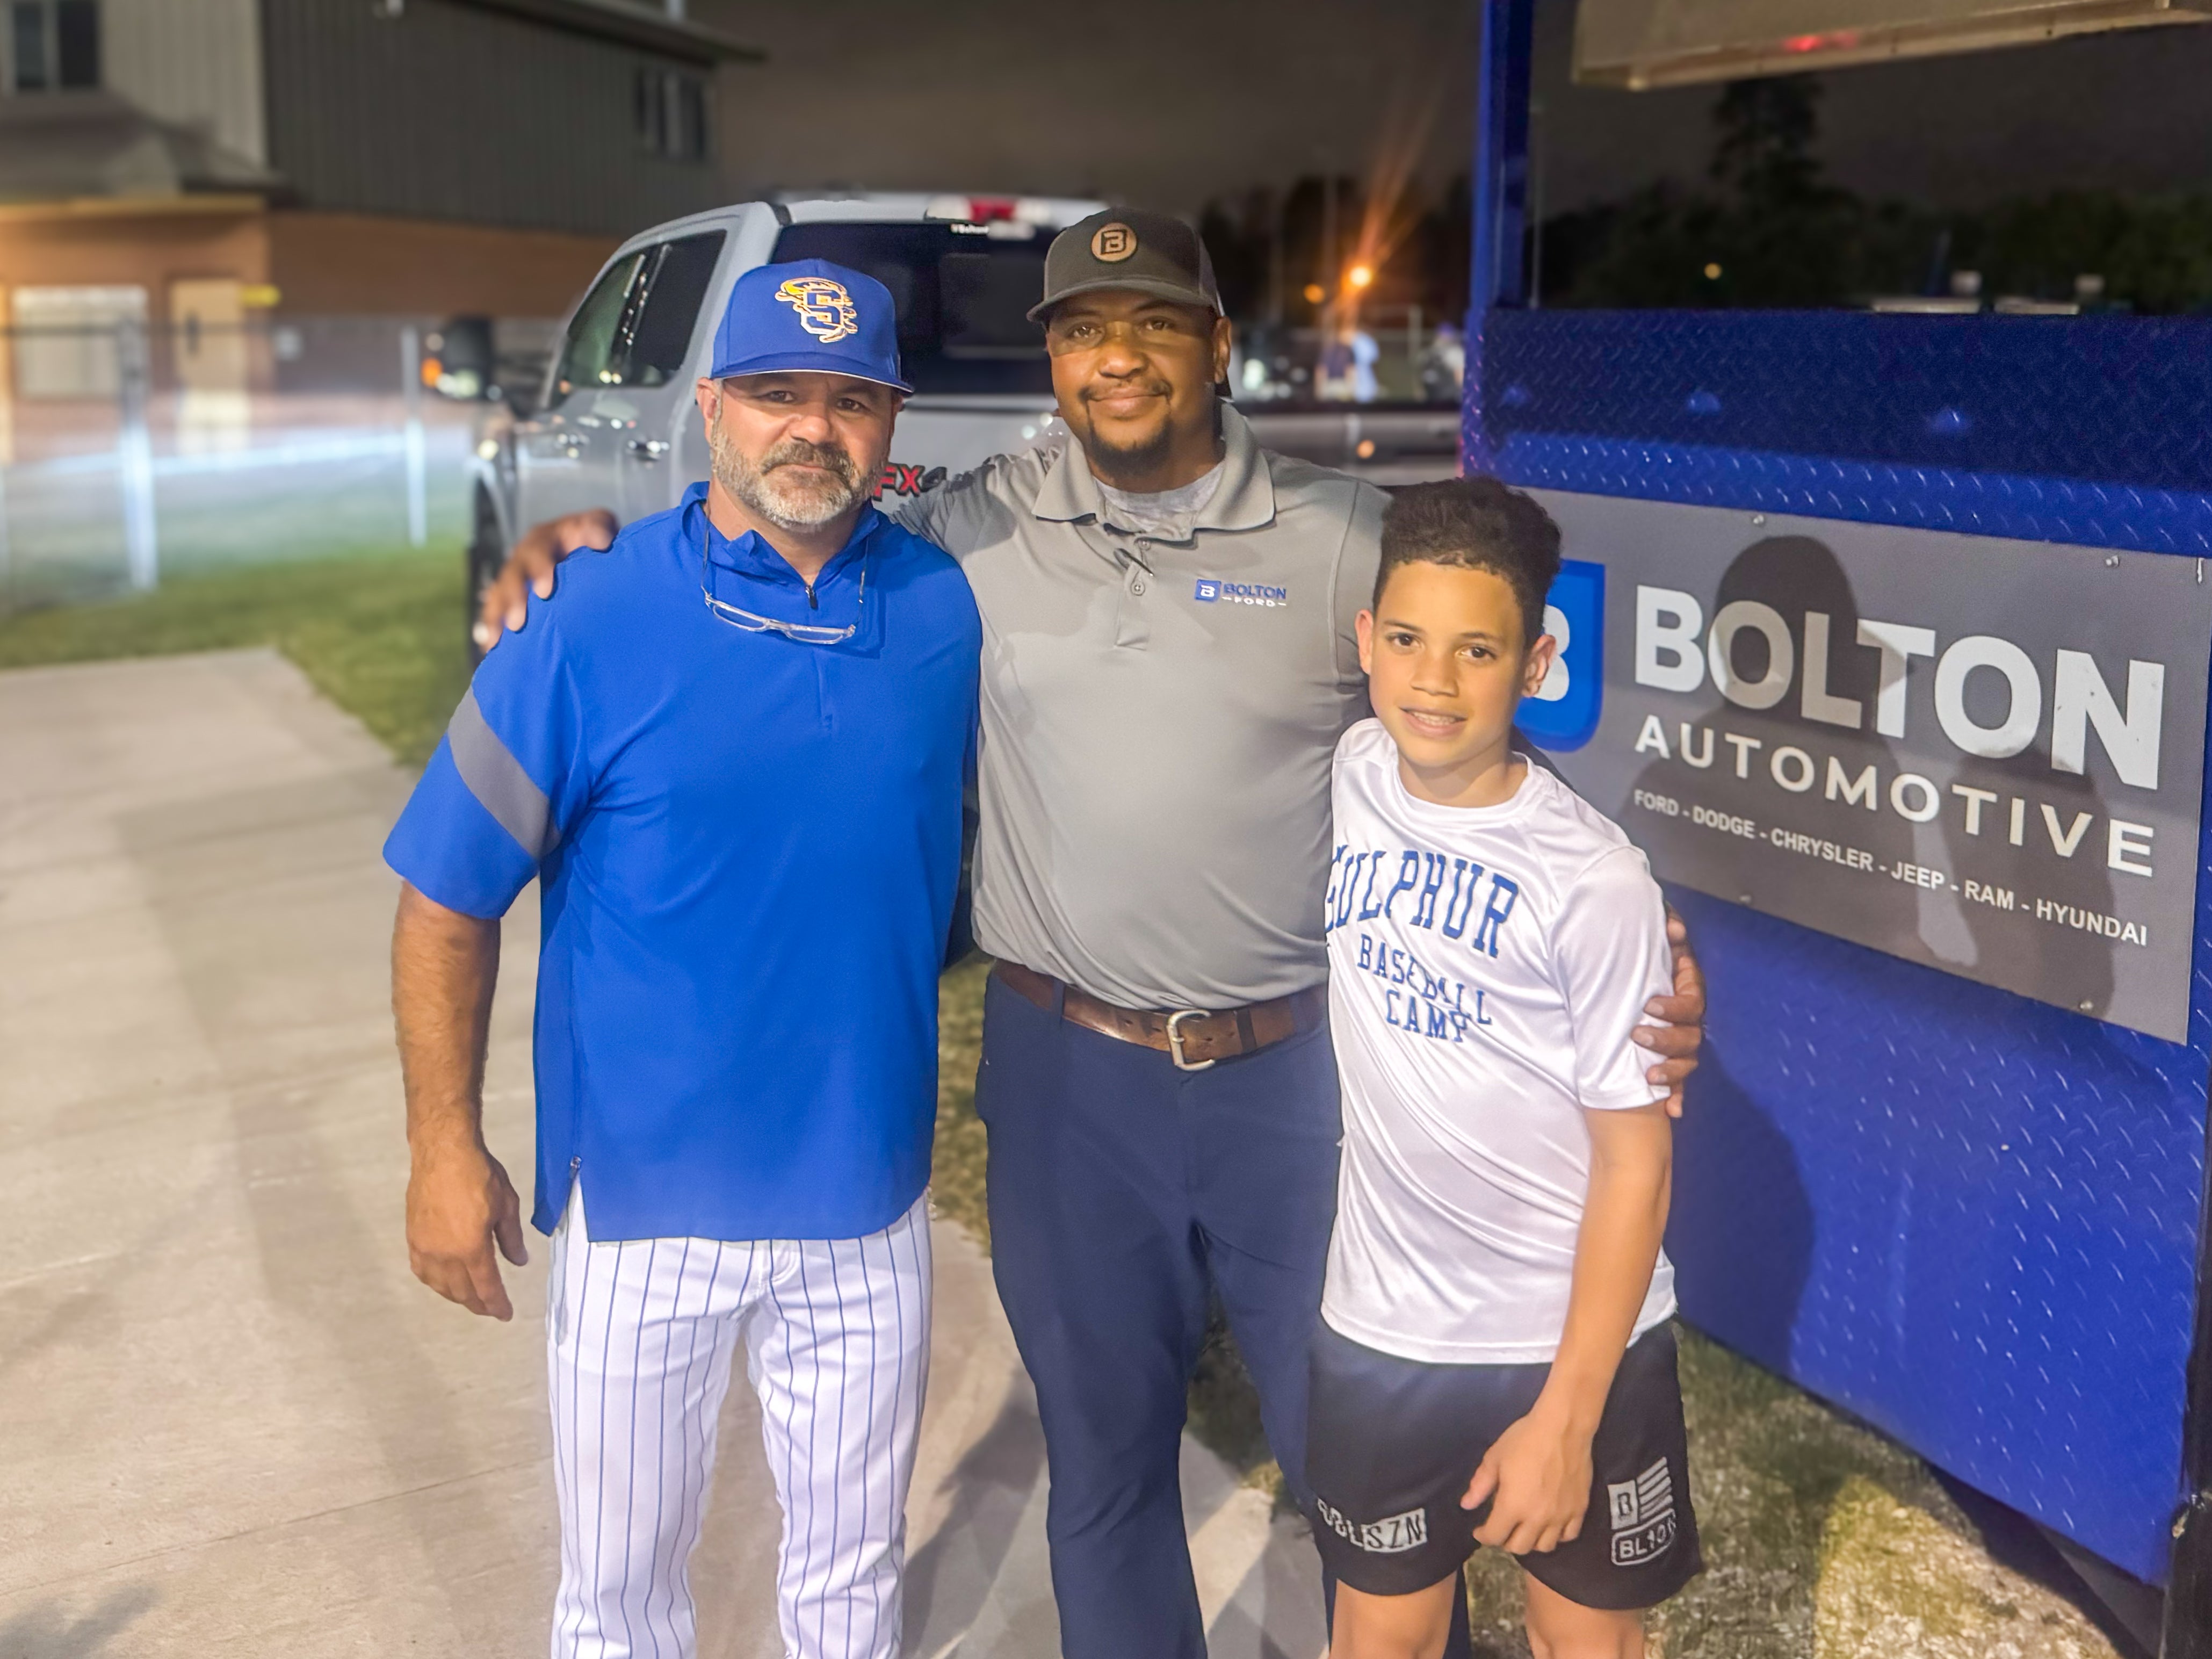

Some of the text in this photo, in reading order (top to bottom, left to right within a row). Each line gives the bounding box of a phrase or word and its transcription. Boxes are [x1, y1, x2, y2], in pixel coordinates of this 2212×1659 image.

[1223, 583, 1286, 600] BOLTON
[1635, 585, 2165, 790] BOLTON
[1633, 789, 1679, 817] FORD
[1692, 805, 1756, 839] DODGE
[1770, 828, 1874, 872] CHRYSLER
[1891, 861, 1945, 890] JEEP
[1964, 879, 2014, 911] RAM
[2036, 898, 2148, 947] HYUNDAI
[1634, 715, 2154, 877] AUTOMOTIVE
[1386, 989, 1468, 1042] CAMP
